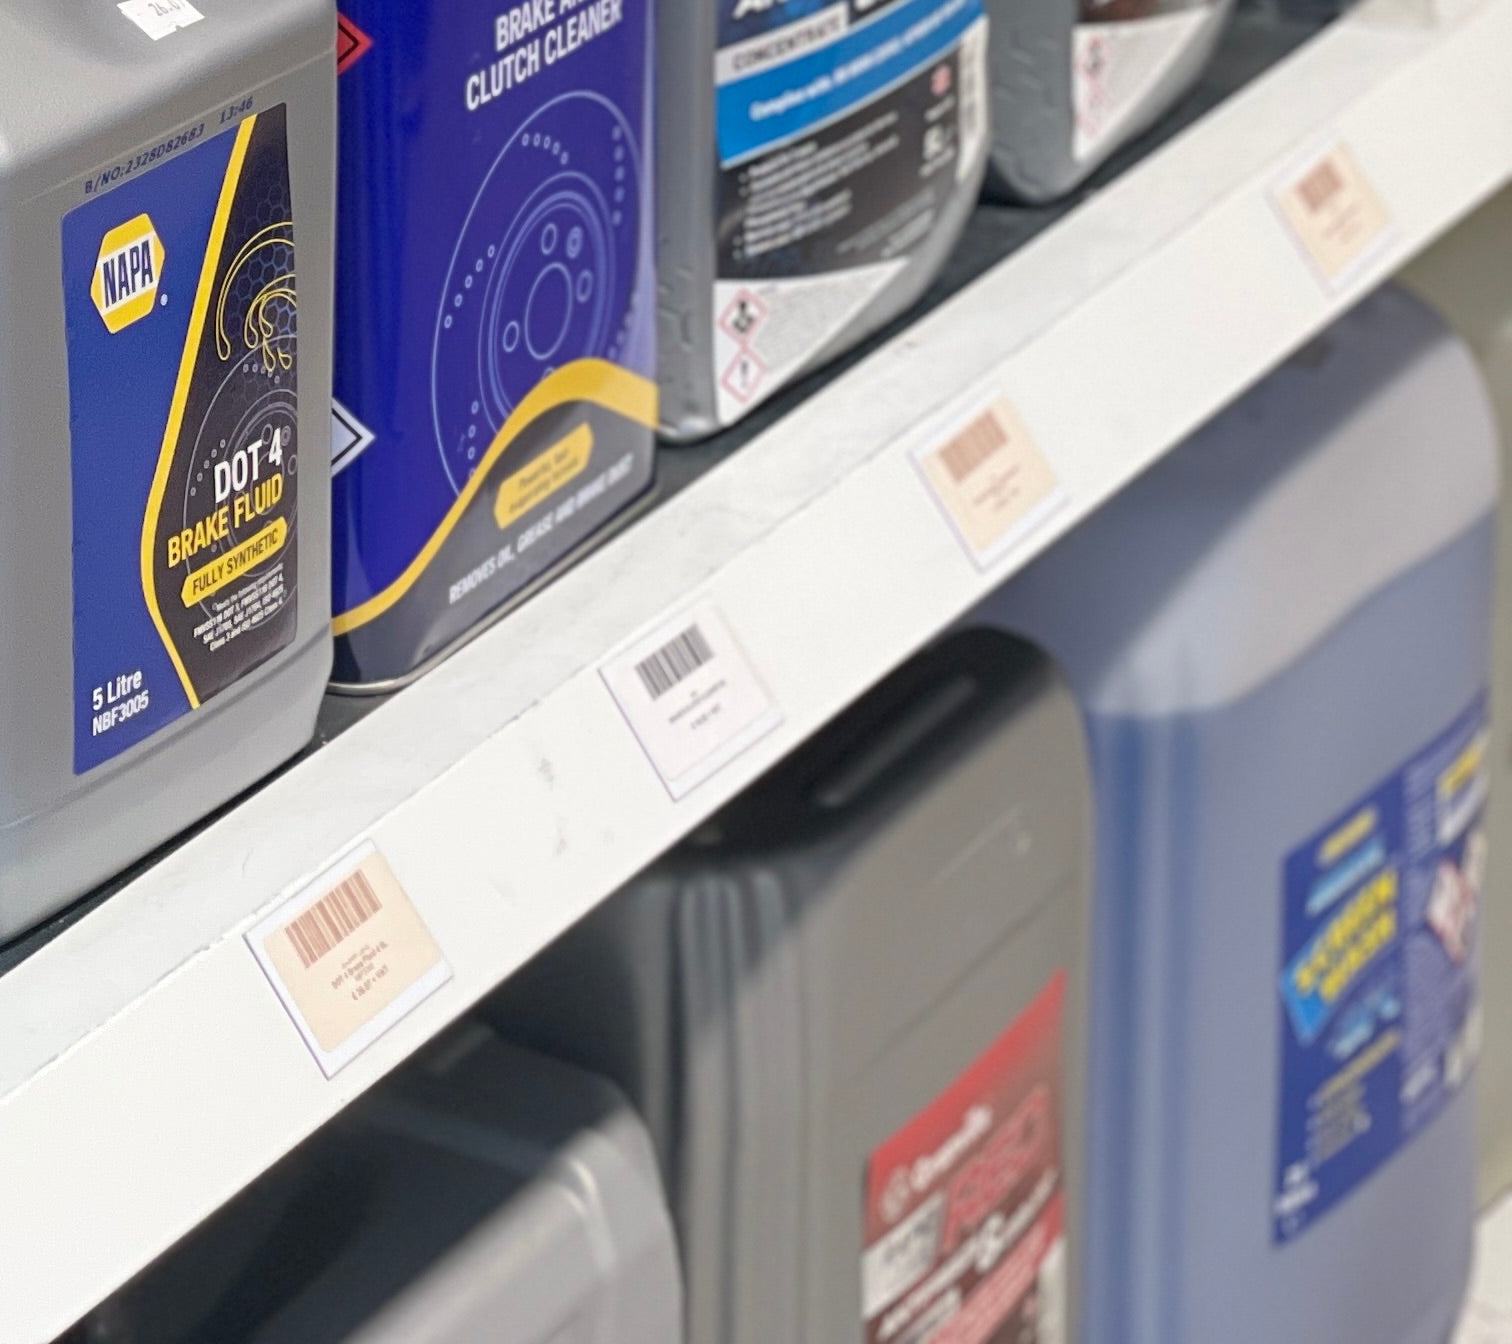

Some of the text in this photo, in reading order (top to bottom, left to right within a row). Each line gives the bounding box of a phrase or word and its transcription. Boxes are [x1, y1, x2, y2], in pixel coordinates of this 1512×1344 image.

[219, 96, 254, 125] 13:46
[466, 45, 541, 112] CLUTCH
[102, 239, 155, 308] NAPA
[215, 427, 283, 503] DOT 4
[168, 472, 283, 568] BRAKE FLUID
[192, 562, 224, 596] FULLY
[226, 527, 279, 576] SYNTHETIC
[449, 555, 496, 605] REMOVES
[517, 511, 554, 554] GREASE
[92, 669, 143, 711] 5 Litre
[92, 689, 150, 737] NBF3005
